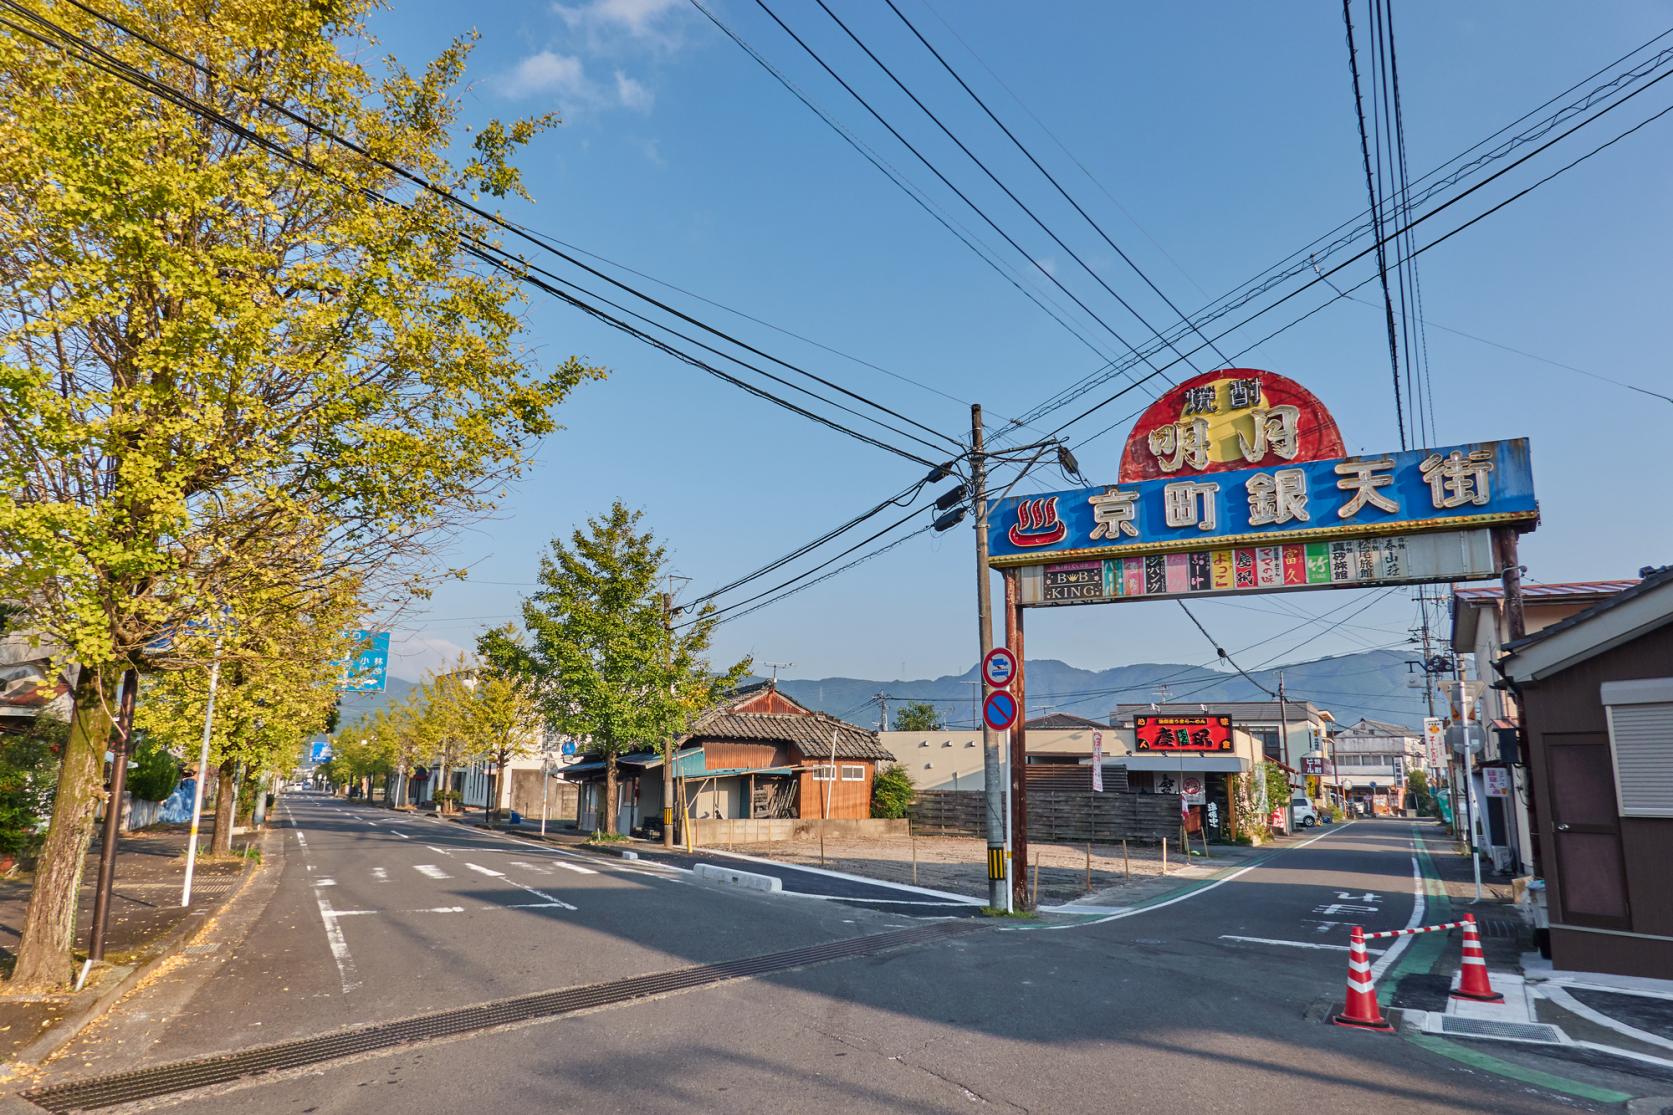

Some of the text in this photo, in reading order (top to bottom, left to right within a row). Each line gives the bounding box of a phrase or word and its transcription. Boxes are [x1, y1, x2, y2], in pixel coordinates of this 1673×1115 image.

[1185, 377, 1263, 414] 焼酎
[1148, 404, 1301, 473] 明月
[1088, 450, 1494, 540] 京町銀天街
[1308, 556, 1328, 573] 竹
[1052, 585, 1095, 599] KING
